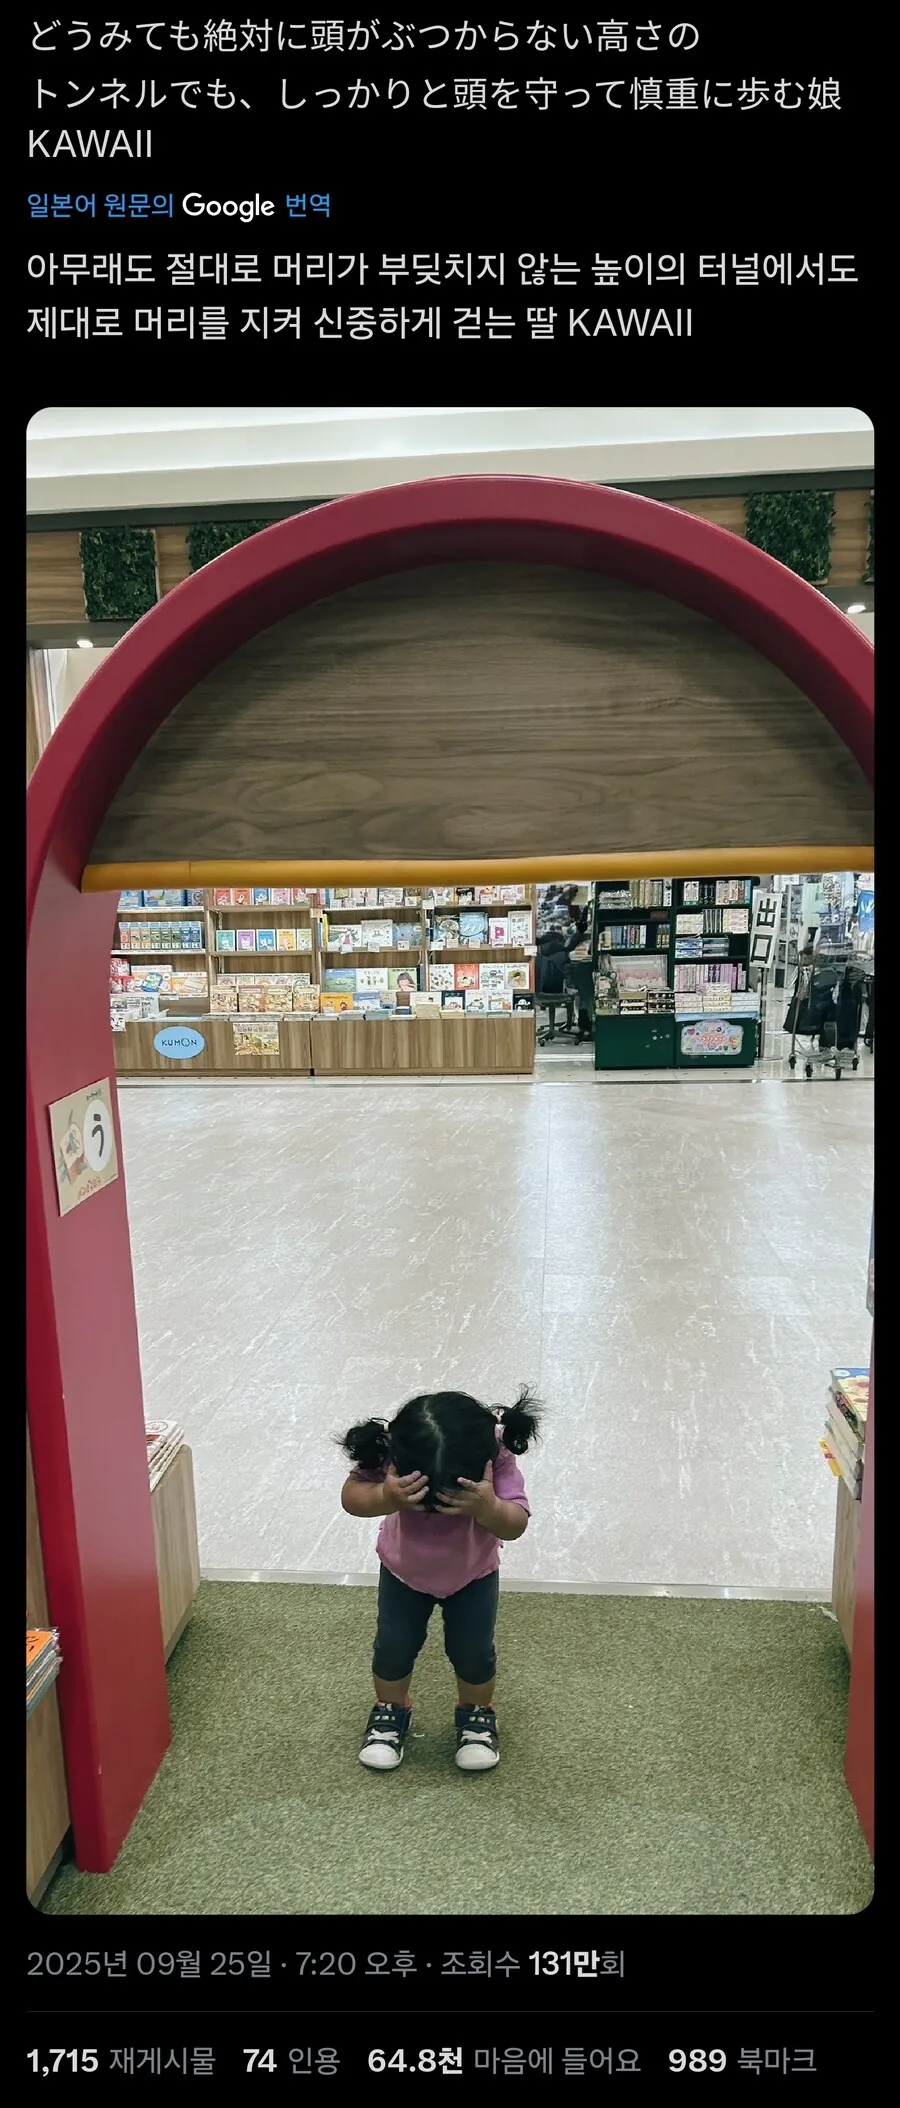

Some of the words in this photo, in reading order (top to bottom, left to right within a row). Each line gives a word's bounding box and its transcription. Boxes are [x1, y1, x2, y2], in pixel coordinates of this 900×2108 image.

[750, 898, 777, 964] 出口
[161, 1037, 198, 1047] KUMON
[91, 1113, 105, 1158] う
